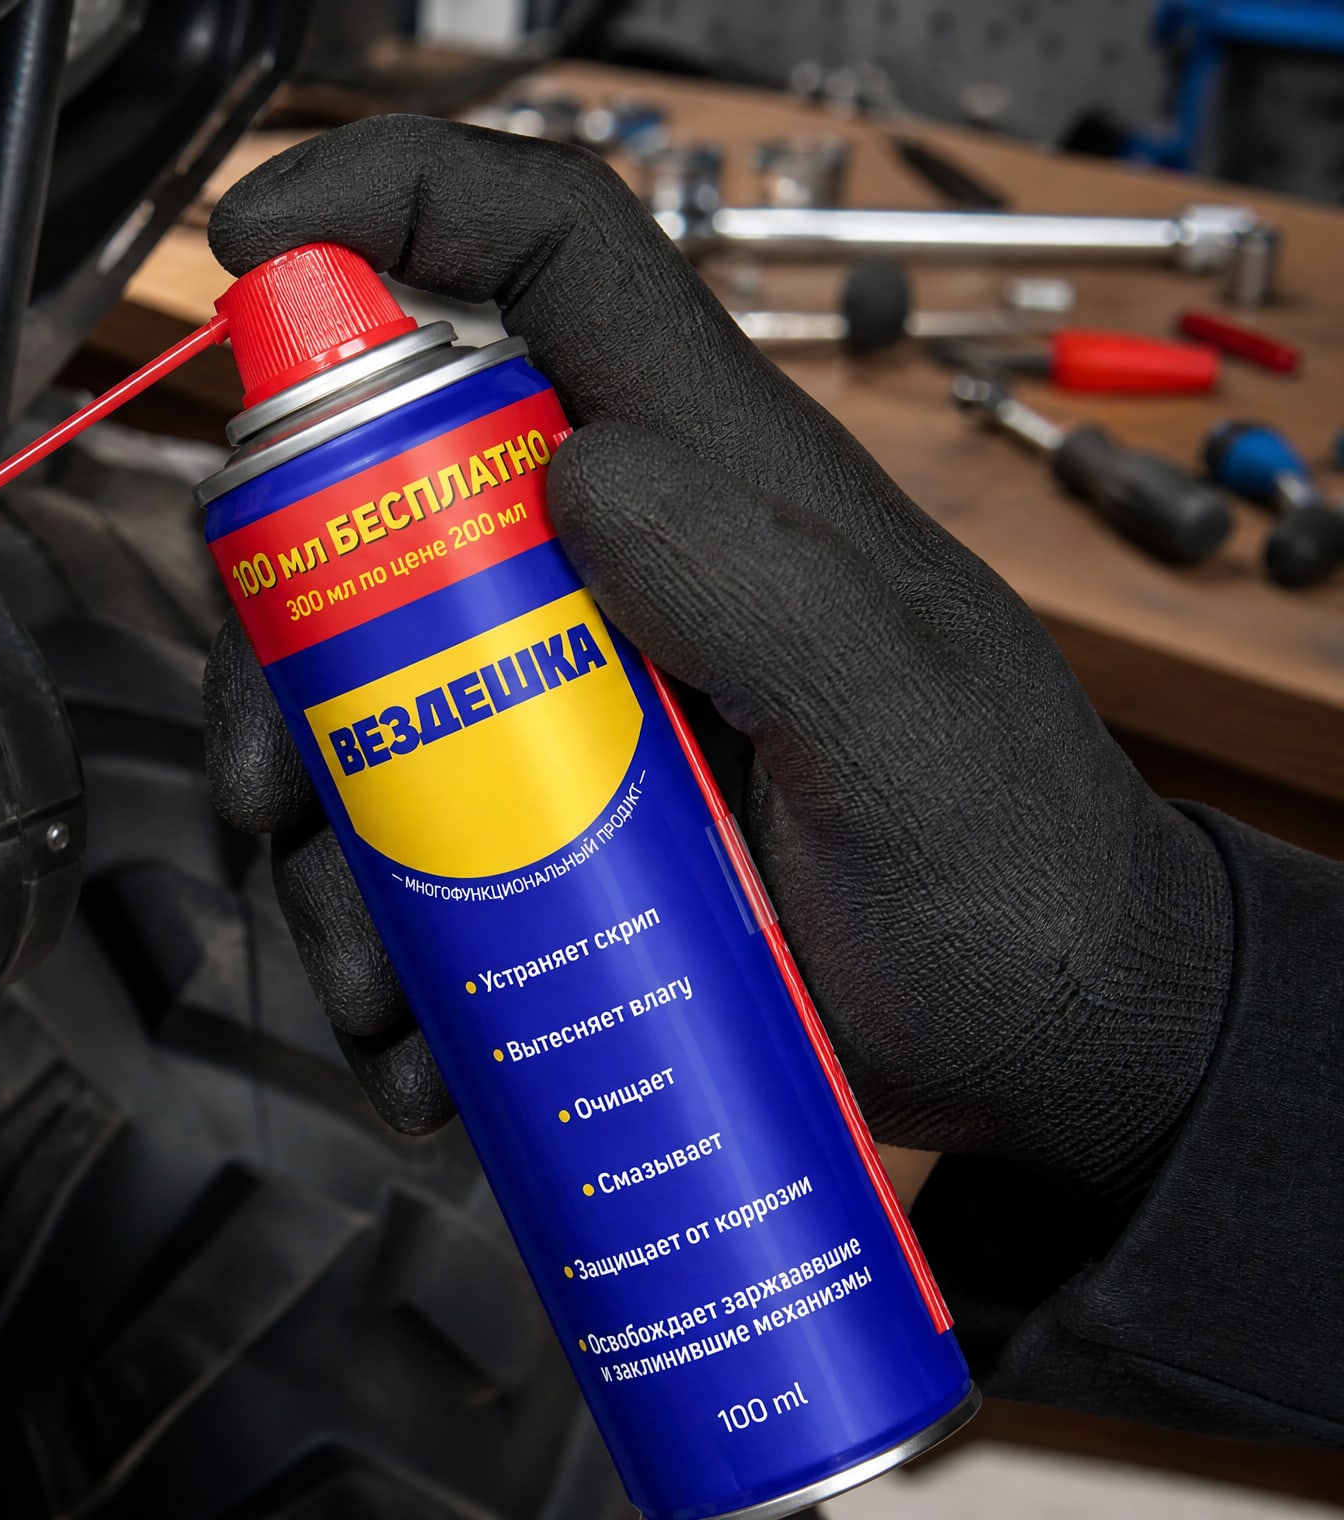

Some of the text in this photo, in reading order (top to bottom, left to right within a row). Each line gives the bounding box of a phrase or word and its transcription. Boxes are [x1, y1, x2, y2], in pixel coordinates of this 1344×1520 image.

[232, 551, 278, 599] 100
[277, 536, 329, 581] мл
[325, 429, 552, 557] БЕСПЛАТНО
[286, 502, 528, 622] 300 мл по цене 200 мл
[328, 622, 608, 777] ВЕЗДЕШКА
[405, 837, 599, 902] МНОГОФУНКЦИОНАЛЬНЫЙ
[478, 907, 661, 993] Устраняет скрип
[506, 975, 694, 1062] Вытесняет влагу
[574, 1067, 676, 1120] Очищает
[597, 1132, 723, 1194] Смазывает
[574, 1175, 814, 1280] Защищает от коррозии
[587, 1301, 718, 1355] Освобождает
[600, 1266, 873, 1383] и заклинившие механизмы
[717, 1381, 809, 1432] 100 ml
